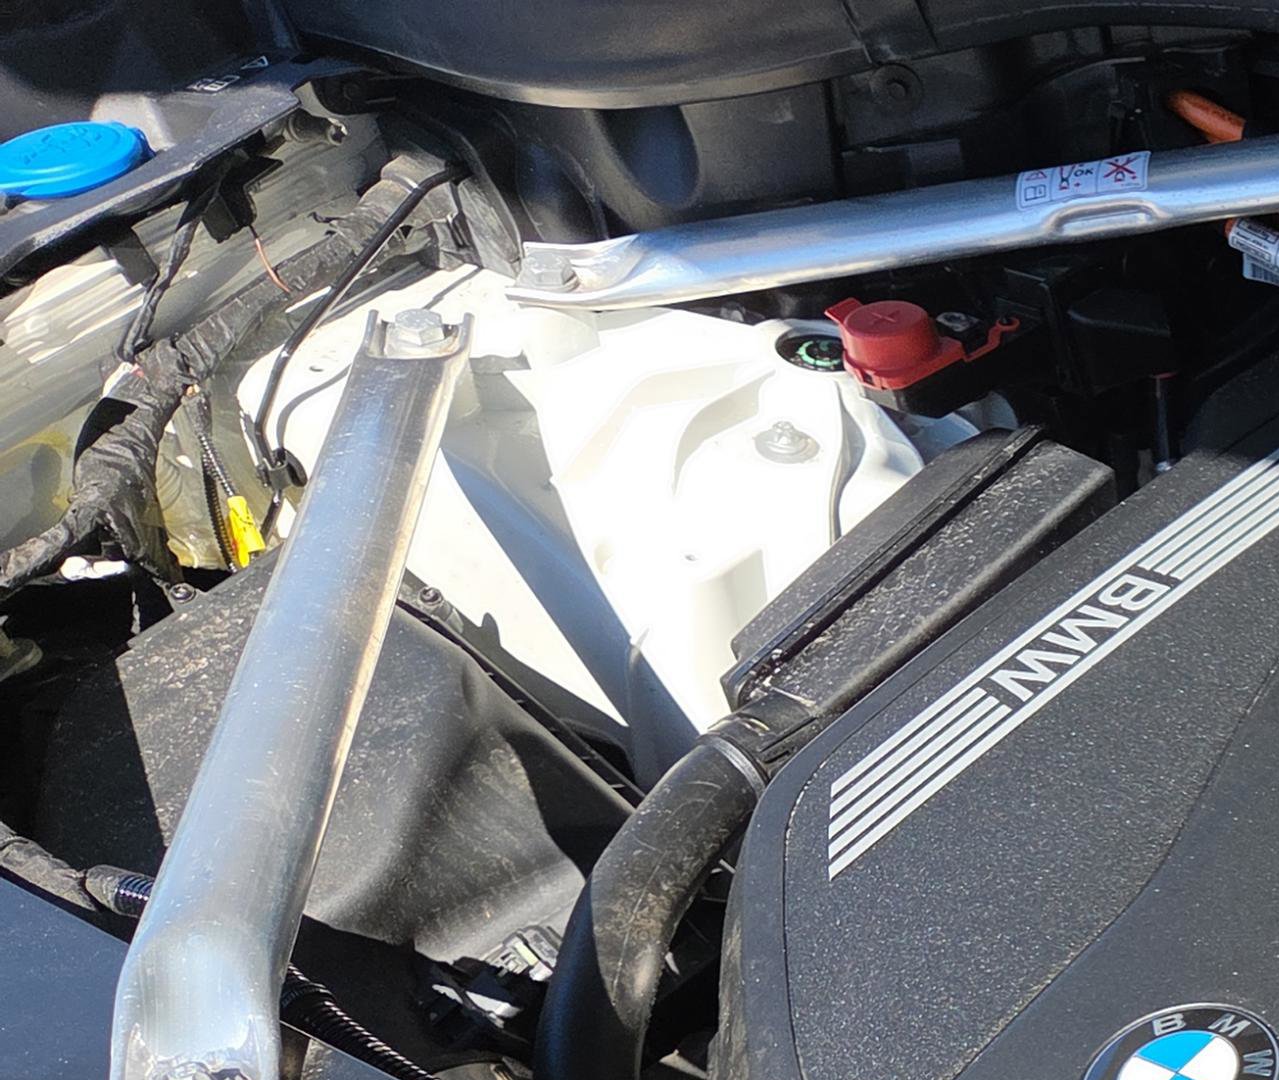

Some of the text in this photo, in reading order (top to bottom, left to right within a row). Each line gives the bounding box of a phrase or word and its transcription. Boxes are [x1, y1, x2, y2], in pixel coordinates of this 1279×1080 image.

[1074, 167, 1095, 178] OK
[989, 573, 1172, 703] BMW
[1151, 1012, 1275, 1078] BMW
